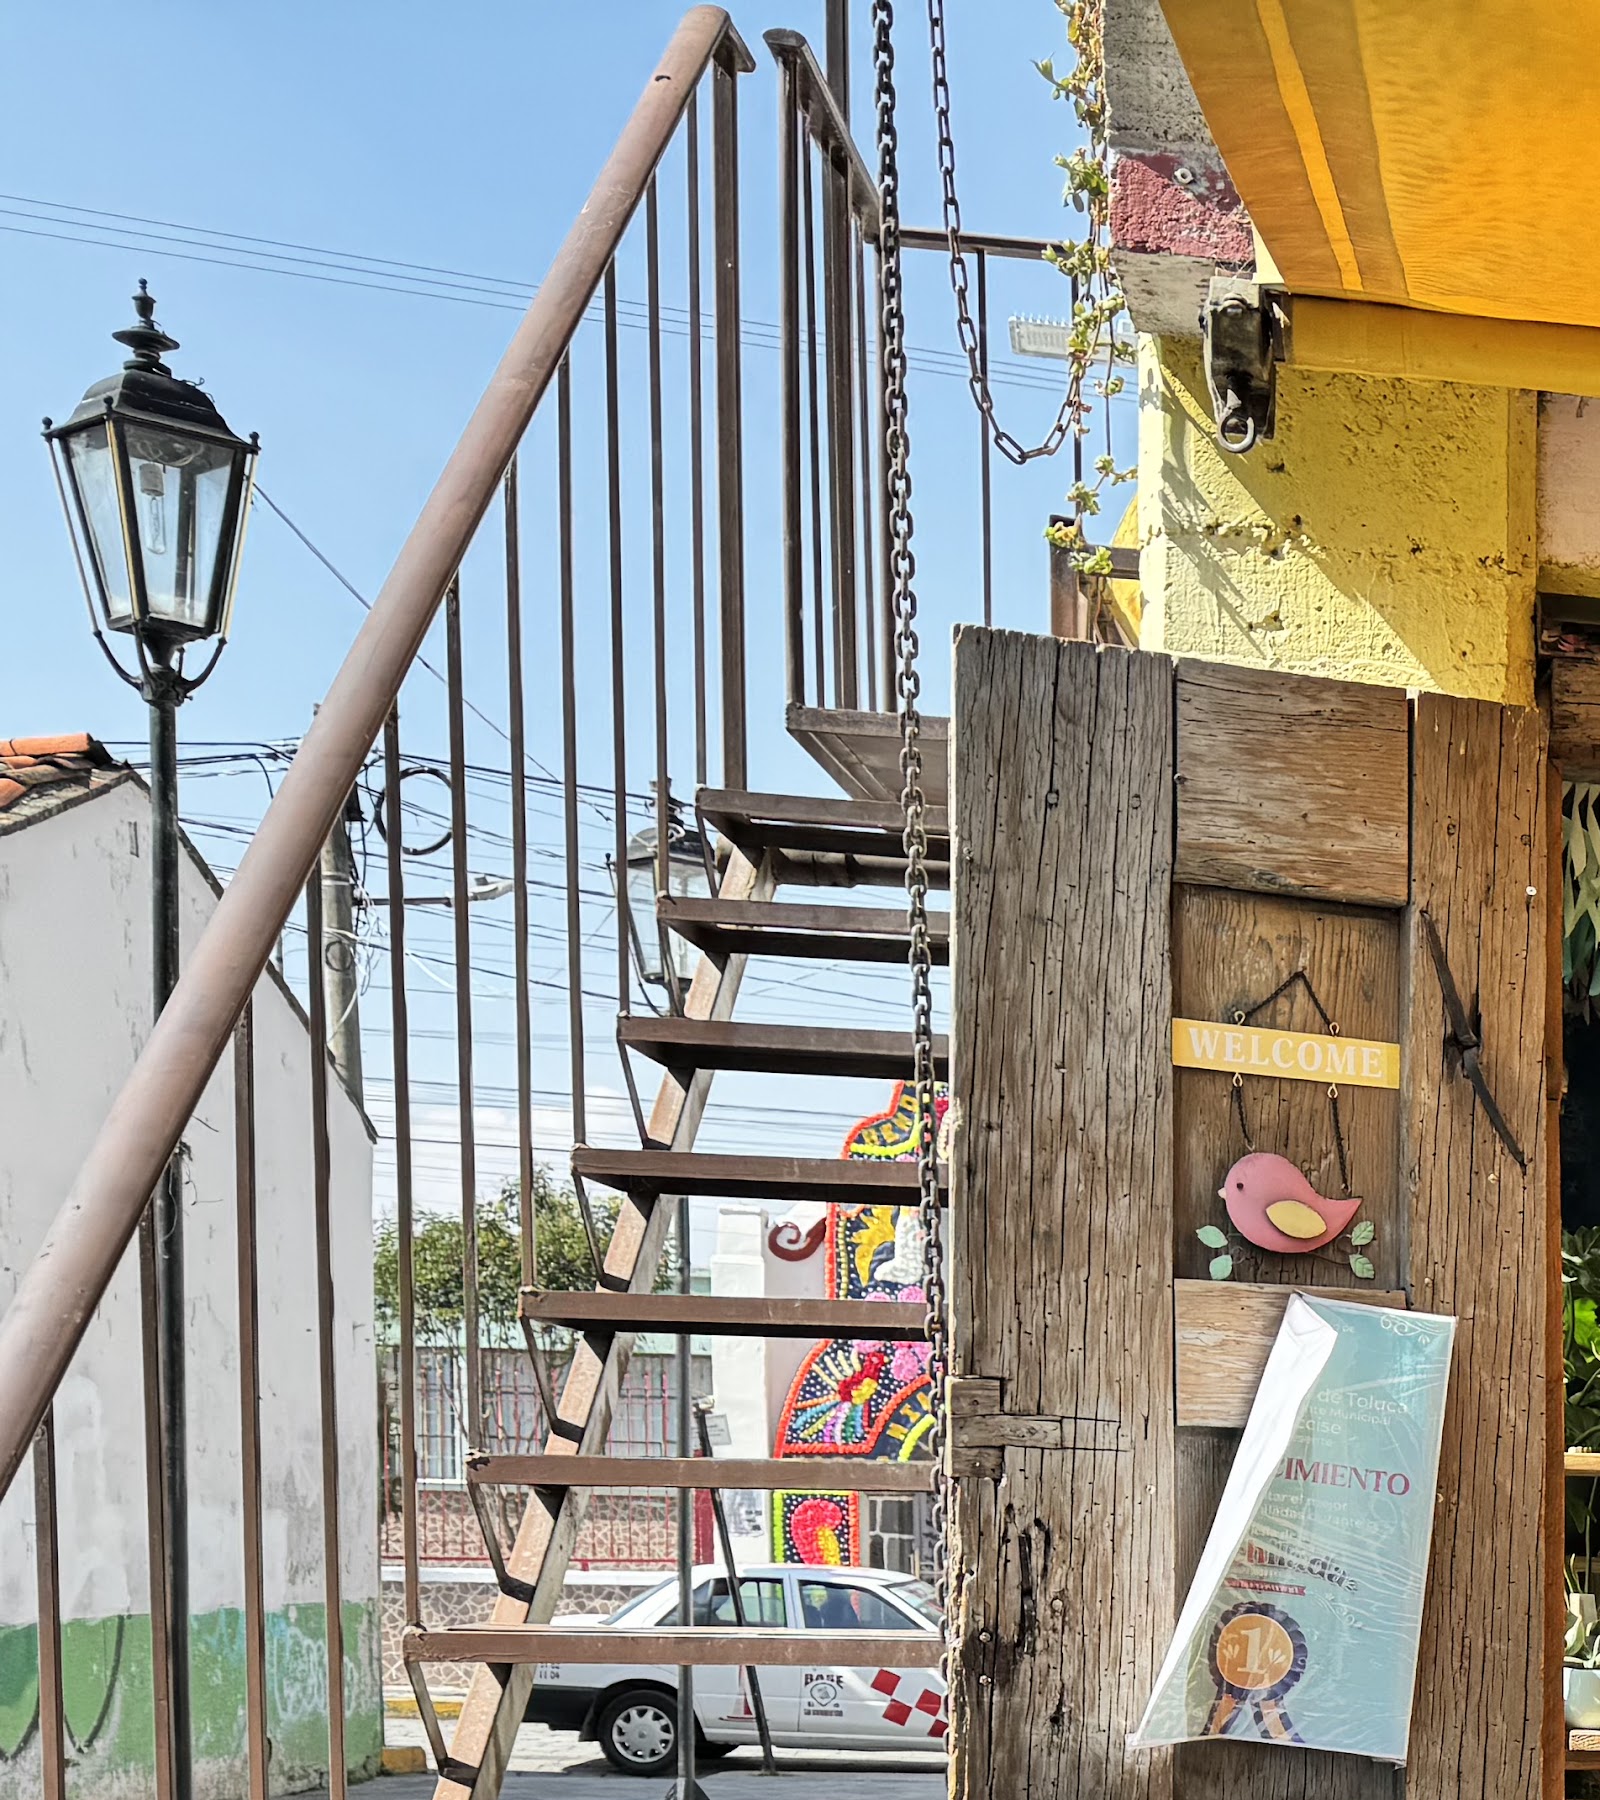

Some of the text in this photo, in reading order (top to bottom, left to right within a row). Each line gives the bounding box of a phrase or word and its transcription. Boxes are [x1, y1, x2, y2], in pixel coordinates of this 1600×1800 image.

[1188, 1026, 1384, 1079] WELCOME
[1346, 1391, 1409, 1414] Toluca
[804, 1673, 844, 1690] BASE
